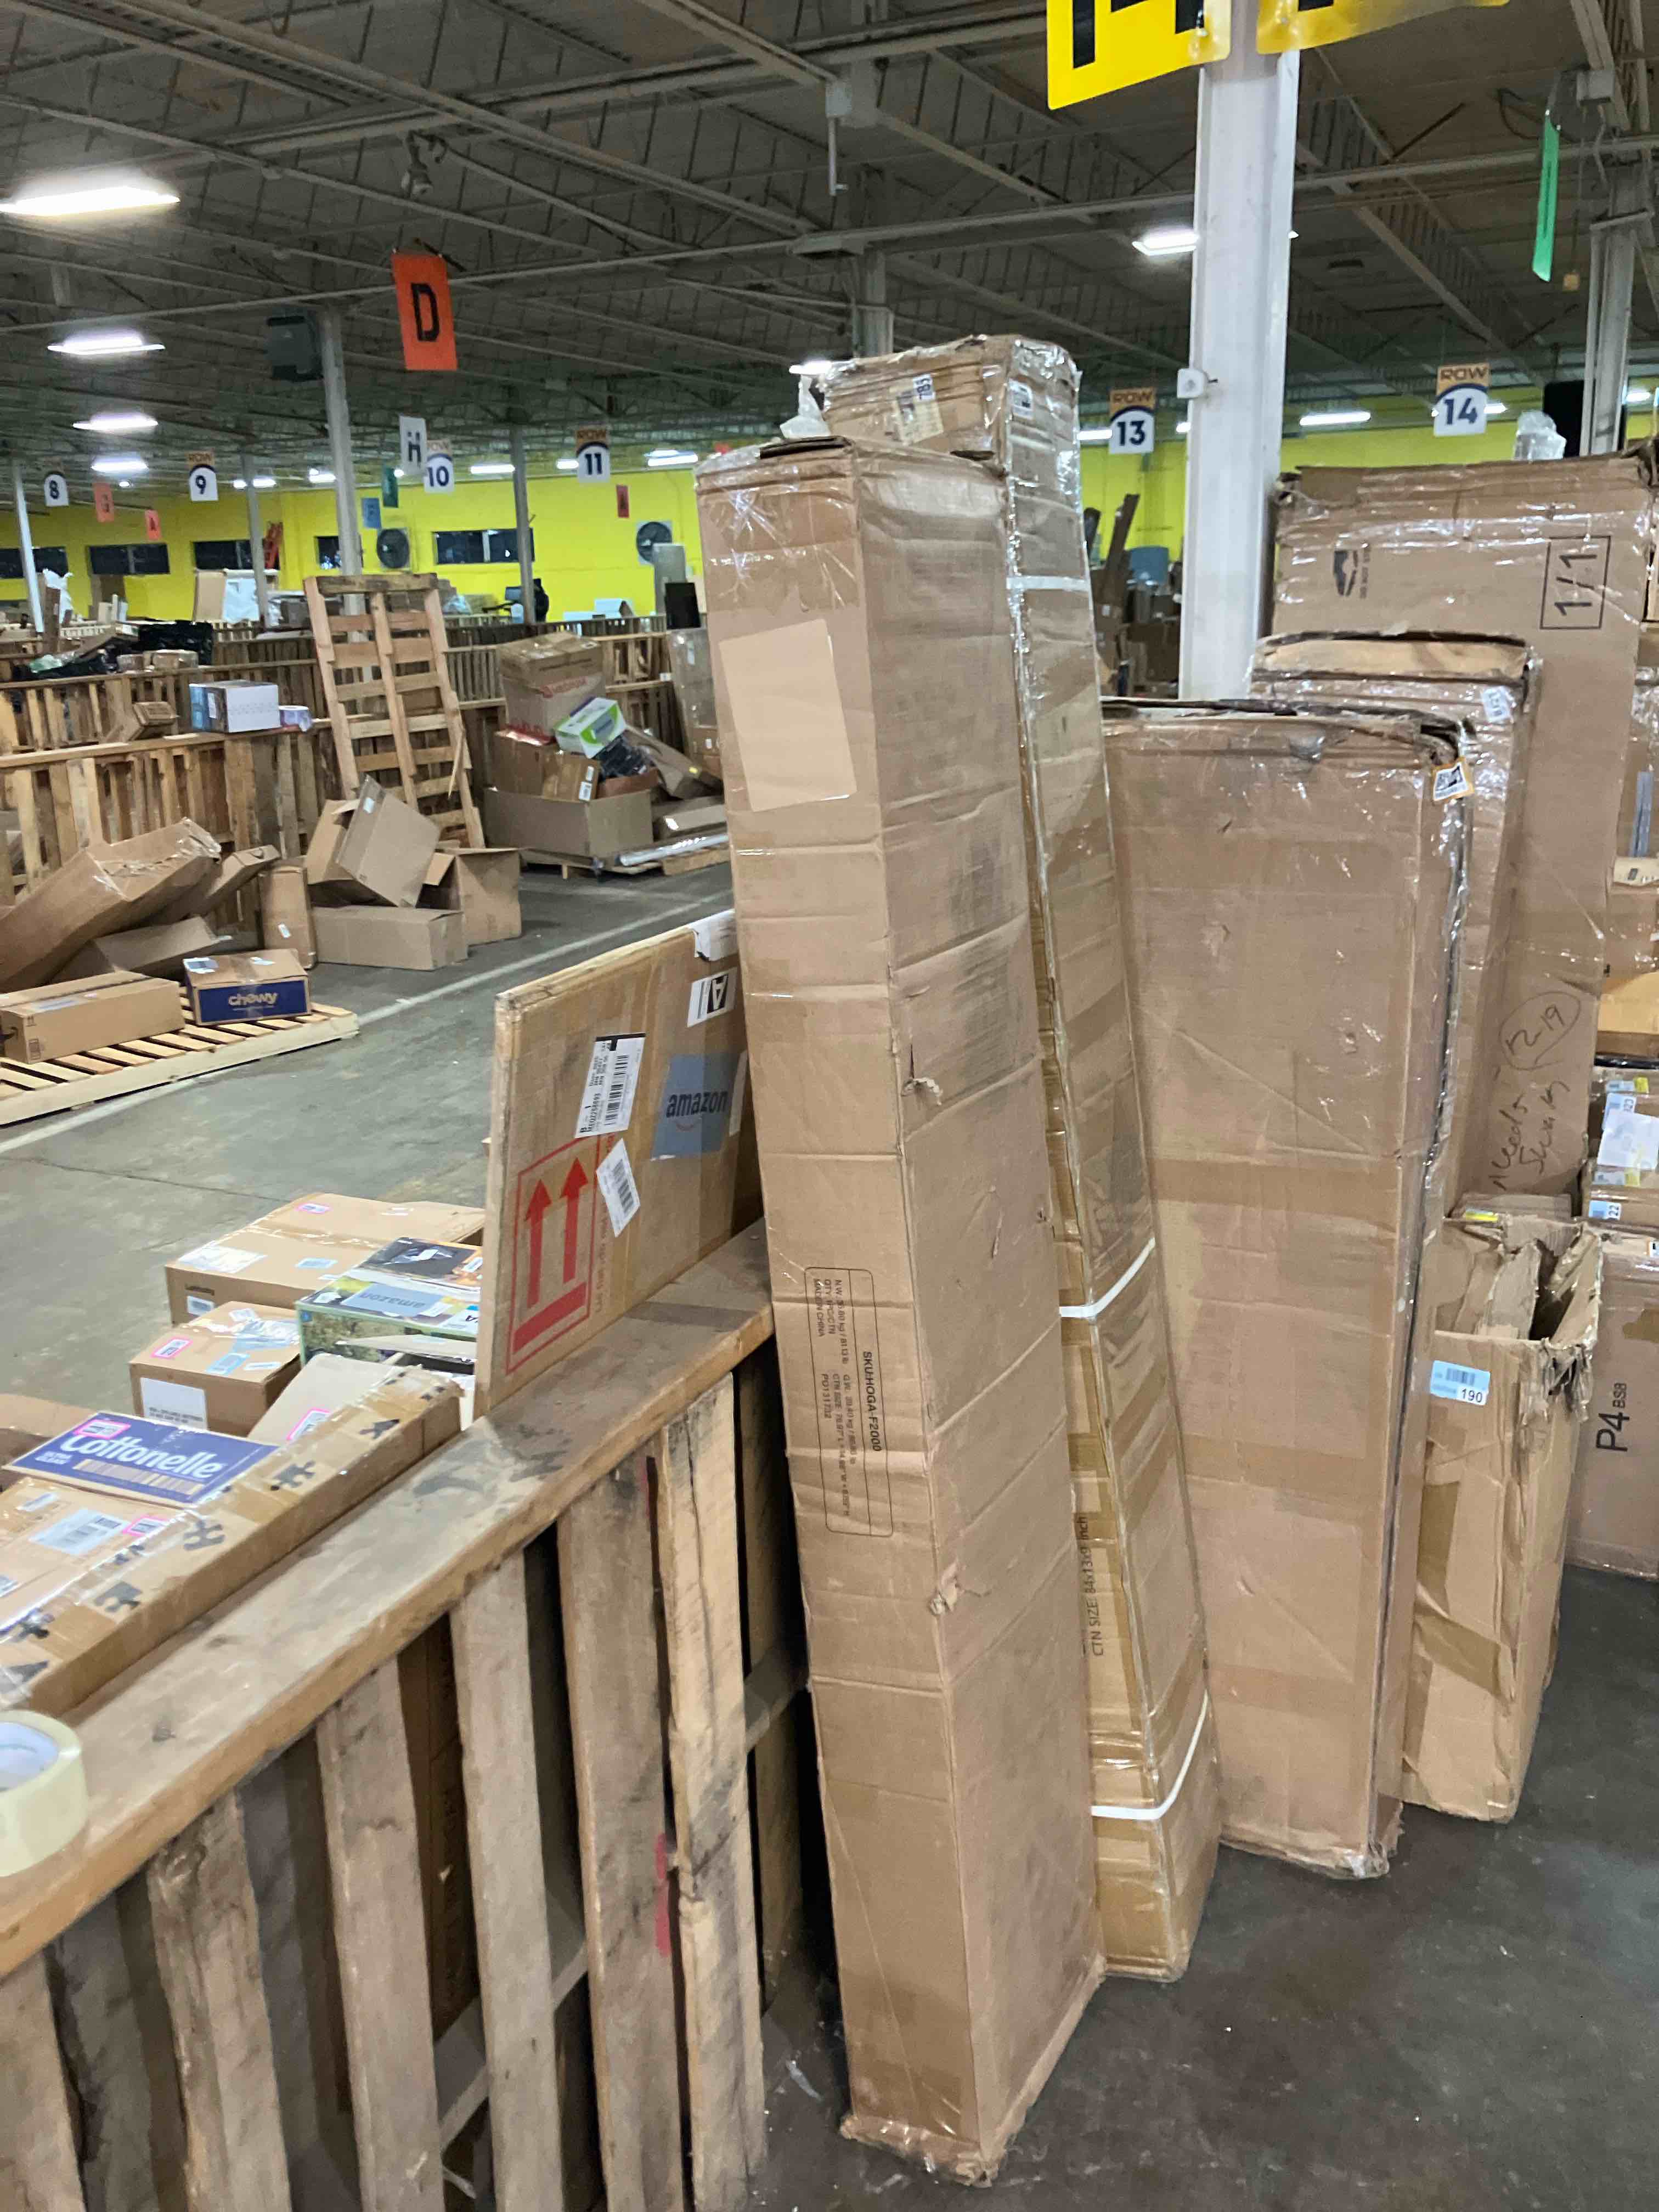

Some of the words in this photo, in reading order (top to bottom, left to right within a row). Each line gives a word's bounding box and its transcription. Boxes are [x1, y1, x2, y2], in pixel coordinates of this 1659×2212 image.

[411, 283, 440, 341] D
[1440, 367, 1488, 380] ROW
[1444, 398, 1477, 425] 14
[1117, 420, 1146, 446] 13
[585, 453, 602, 475] 11
[195, 475, 207, 494] 9
[428, 466, 449, 487] 10
[49, 480, 60, 500] 8
[1554, 554, 1597, 616] 1/1
[228, 992, 278, 1006] chewy
[665, 1091, 729, 1119] amazon
[359, 1293, 426, 1308] amazon
[1462, 1388, 1483, 1403] 190
[1595, 1412, 1630, 1452] P4
[60, 1435, 223, 1479] Cottonelle
[1076, 1516, 1090, 1540] inch
[1092, 1631, 1104, 1656] CTN
